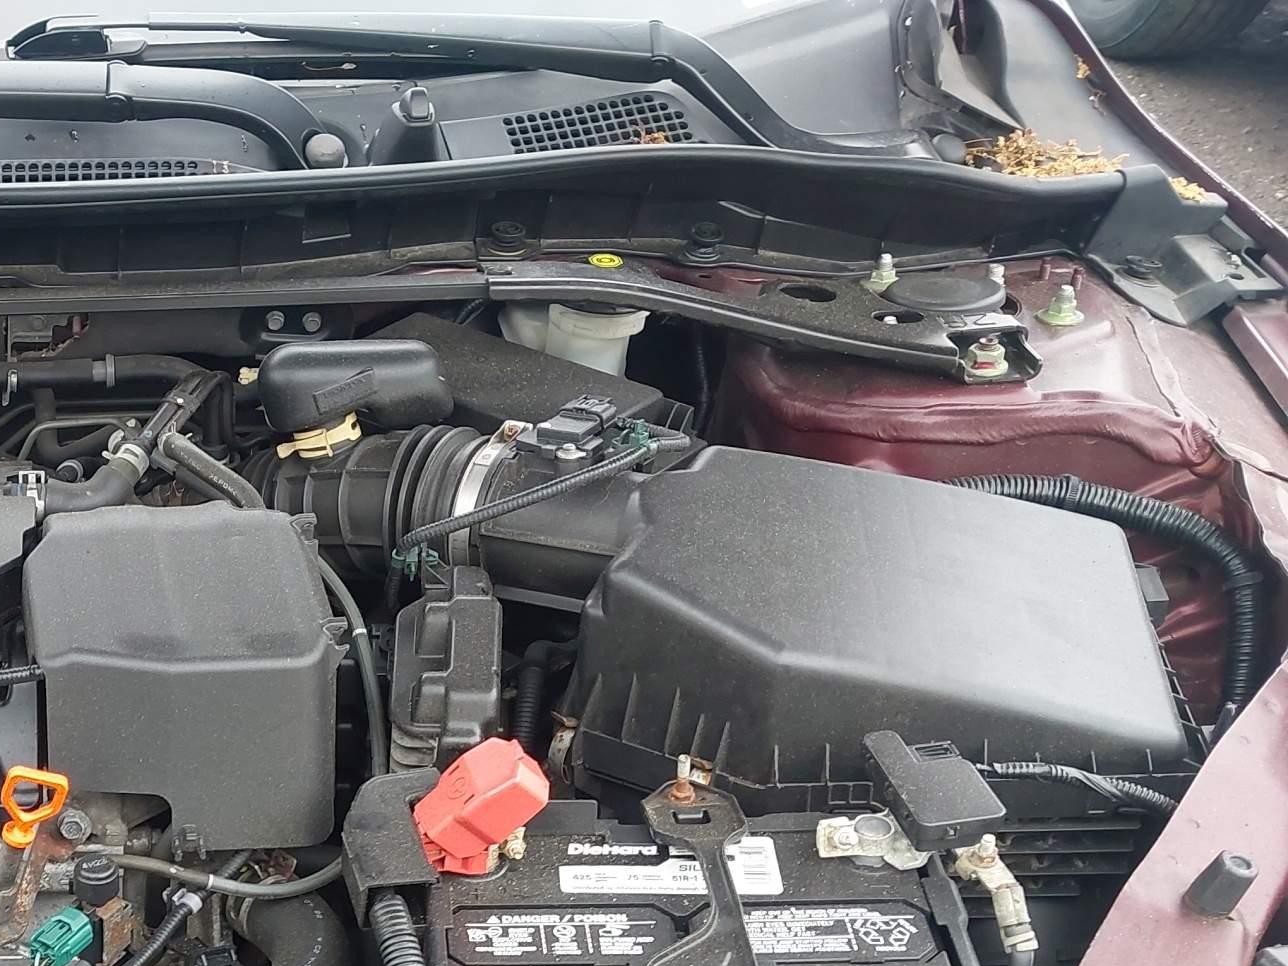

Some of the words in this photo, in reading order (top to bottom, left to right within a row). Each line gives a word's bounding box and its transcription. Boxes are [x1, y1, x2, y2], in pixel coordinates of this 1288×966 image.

[567, 843, 660, 856] DieHard
[679, 864, 701, 872] SIL
[501, 915, 561, 923] DANGER
[574, 914, 628, 922] POISON
